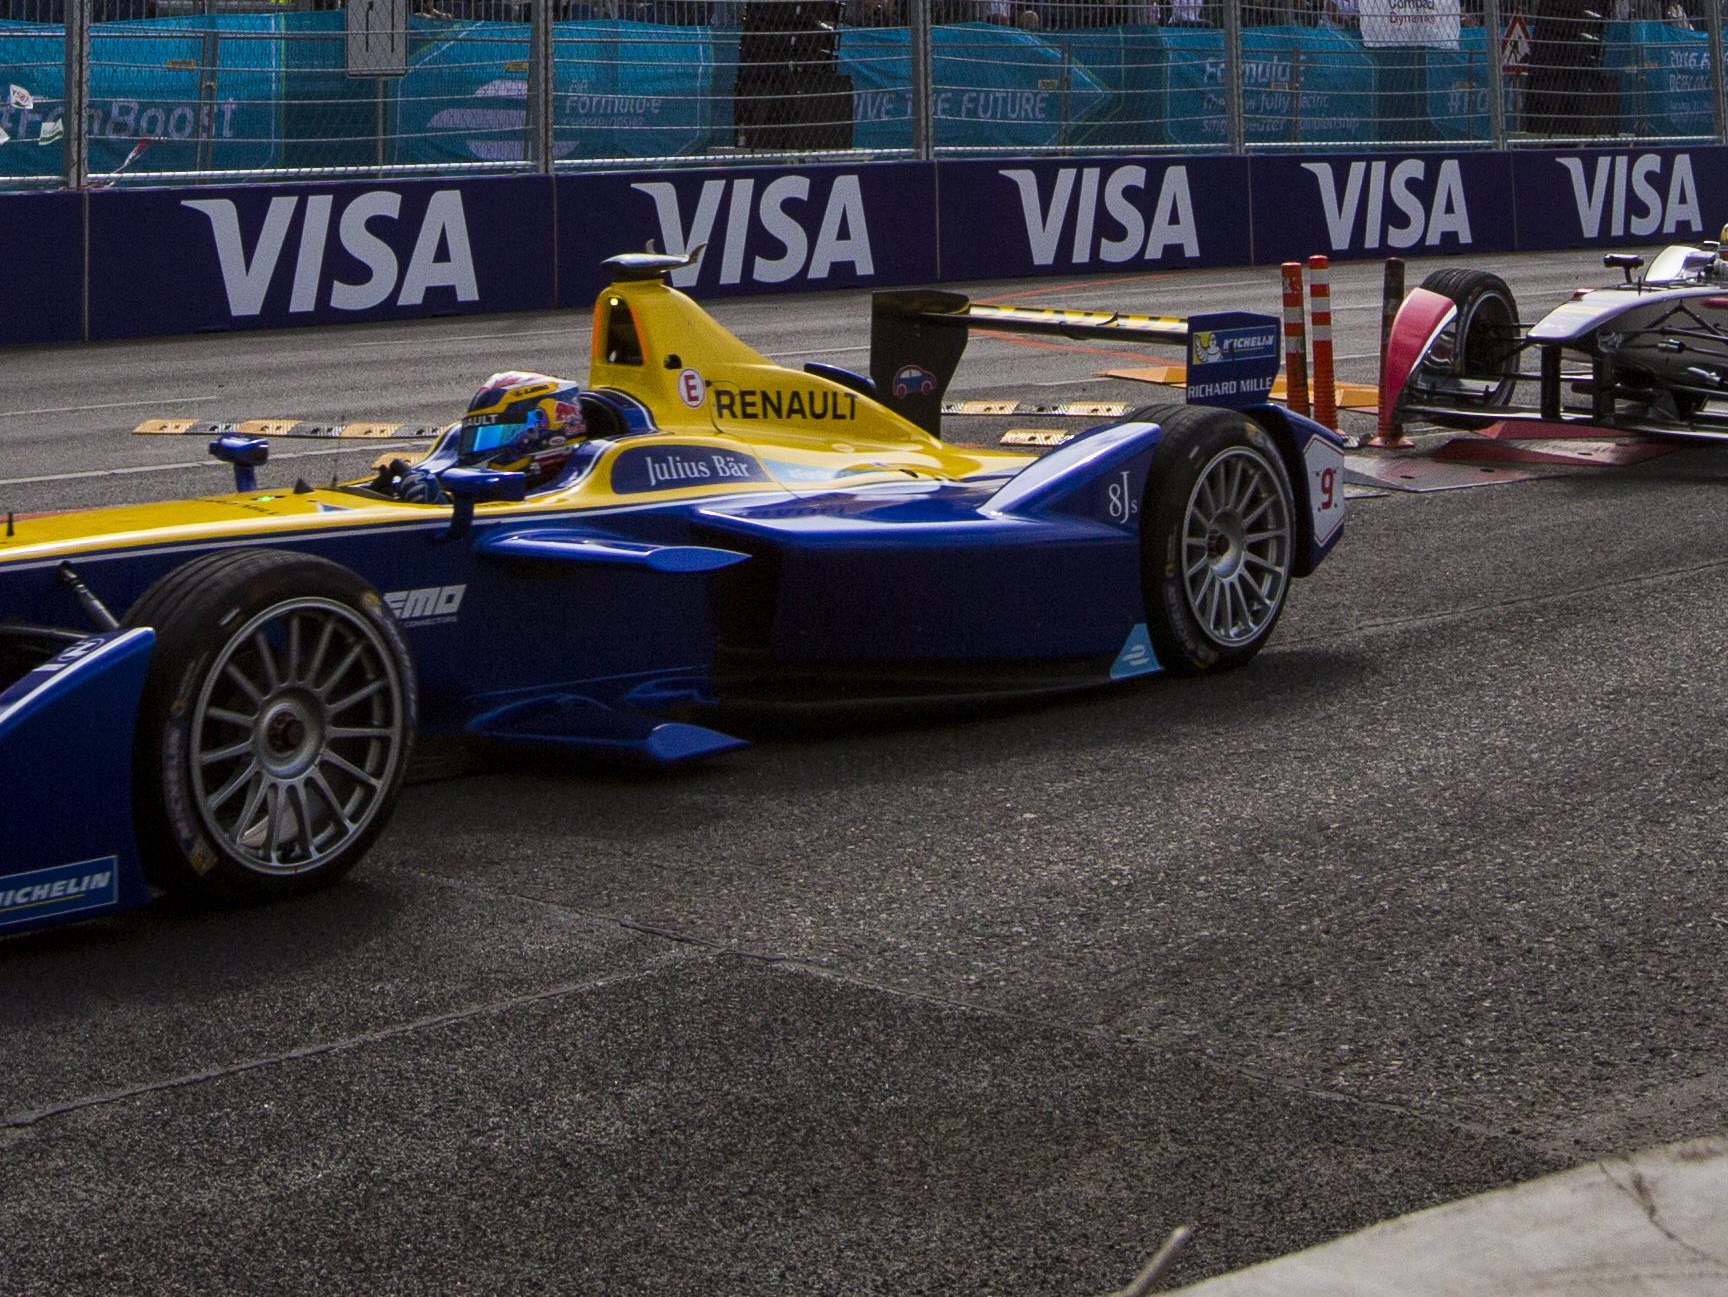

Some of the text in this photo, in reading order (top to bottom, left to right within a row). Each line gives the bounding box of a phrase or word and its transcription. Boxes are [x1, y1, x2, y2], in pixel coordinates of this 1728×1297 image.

[959, 90, 1050, 120] FUTURE
[997, 164, 1201, 266] VISA
[1299, 159, 1473, 251] VISA
[1554, 153, 1704, 239] VISA
[180, 189, 480, 317] VISA
[629, 174, 875, 288] VISA
[1222, 334, 1275, 351] MICHELIN
[682, 374, 858, 420] E RENAULT
[1187, 377, 1273, 400] RICHARD MILLE
[645, 454, 752, 487] Julius Bär
[1321, 467, 1335, 510] 9
